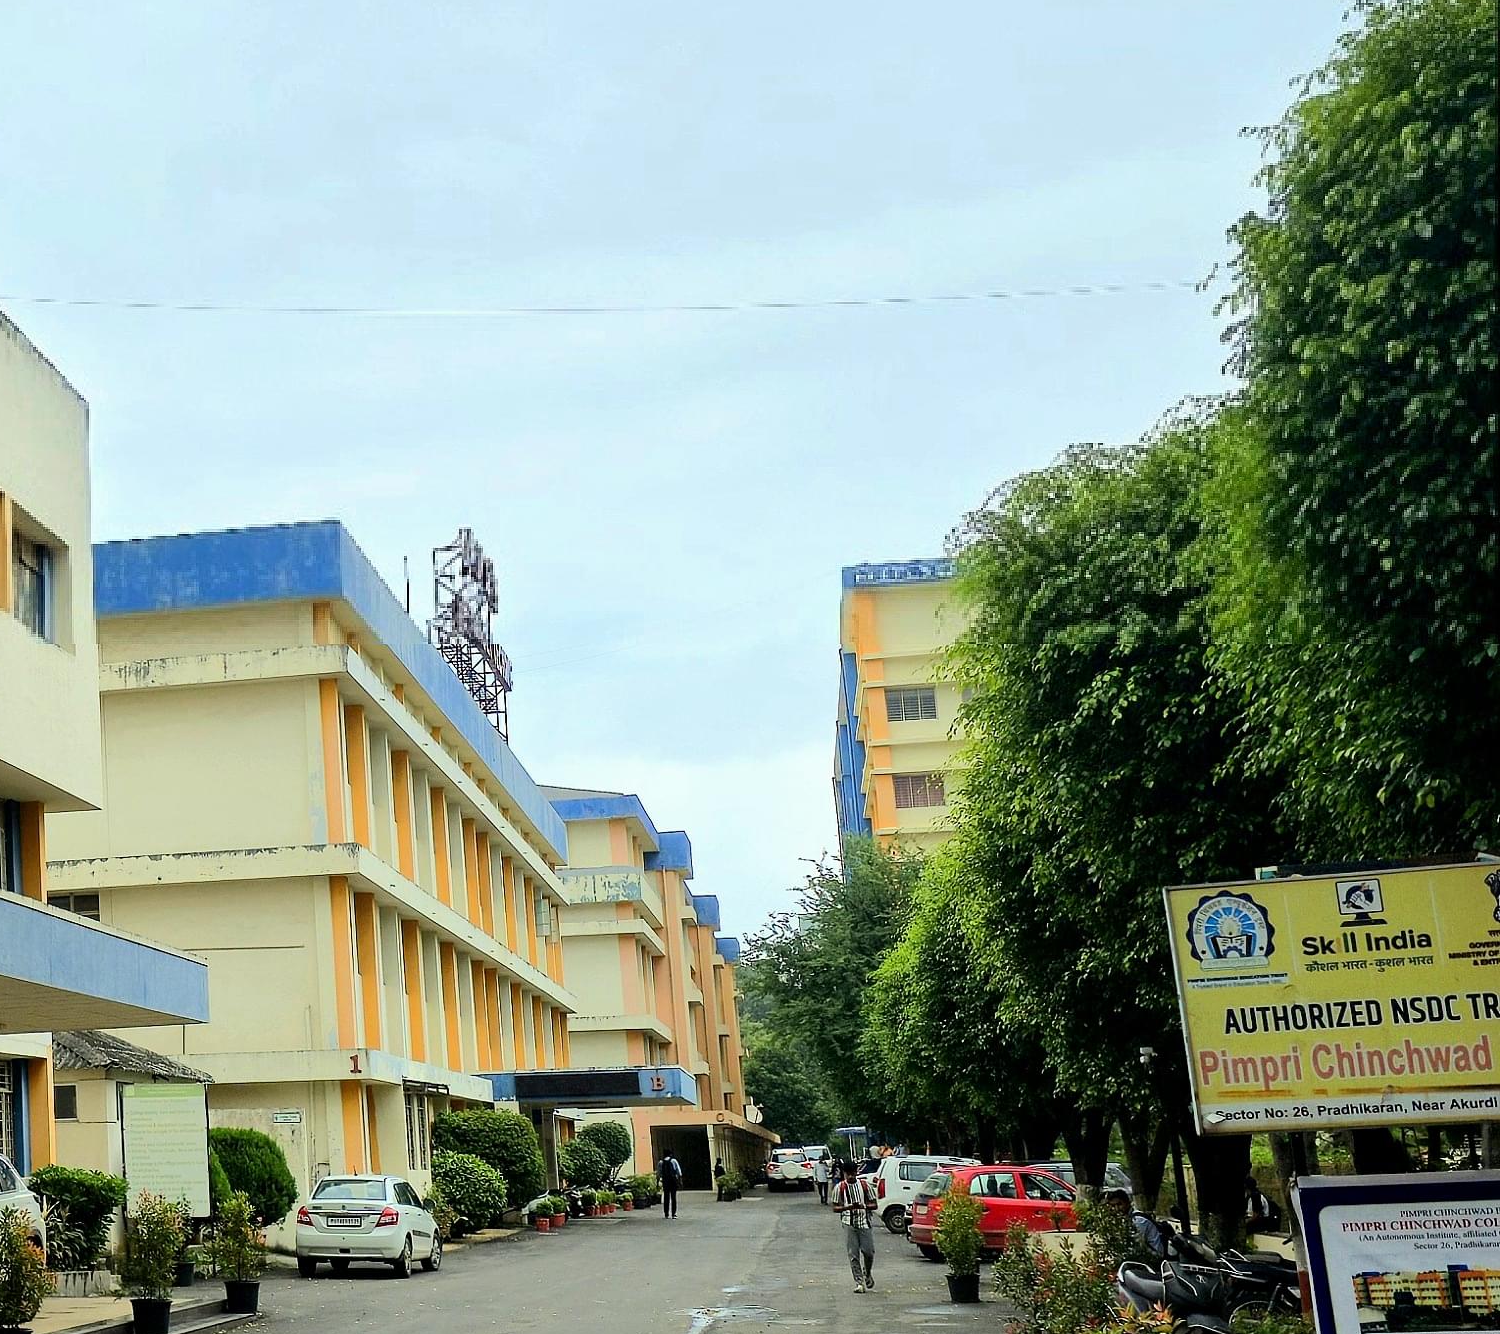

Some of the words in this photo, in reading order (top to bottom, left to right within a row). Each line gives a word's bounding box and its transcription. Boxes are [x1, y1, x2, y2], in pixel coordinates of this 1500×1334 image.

[1365, 929, 1432, 952] India
[1341, 960, 1367, 970] भारत
[1407, 955, 1434, 966] भारत
[1225, 1000, 1382, 1034] AUTHORIZED
[1391, 995, 1461, 1024] NSDC
[350, 1054, 362, 1073] 1
[1200, 1045, 1302, 1091] Pimpri
[1312, 1034, 1493, 1080] Chinchwad
[650, 1075, 665, 1091] B
[1265, 1108, 1288, 1118] No:
[1292, 1106, 1313, 1117] 26,
[1317, 1102, 1408, 1116] Pradhikaran,
[1412, 1100, 1445, 1111] Near
[1450, 1097, 1498, 1109] Akurdi
[1342, 1221, 1387, 1232] PIMPRI
[1390, 1218, 1471, 1230] CHINCHWAD
